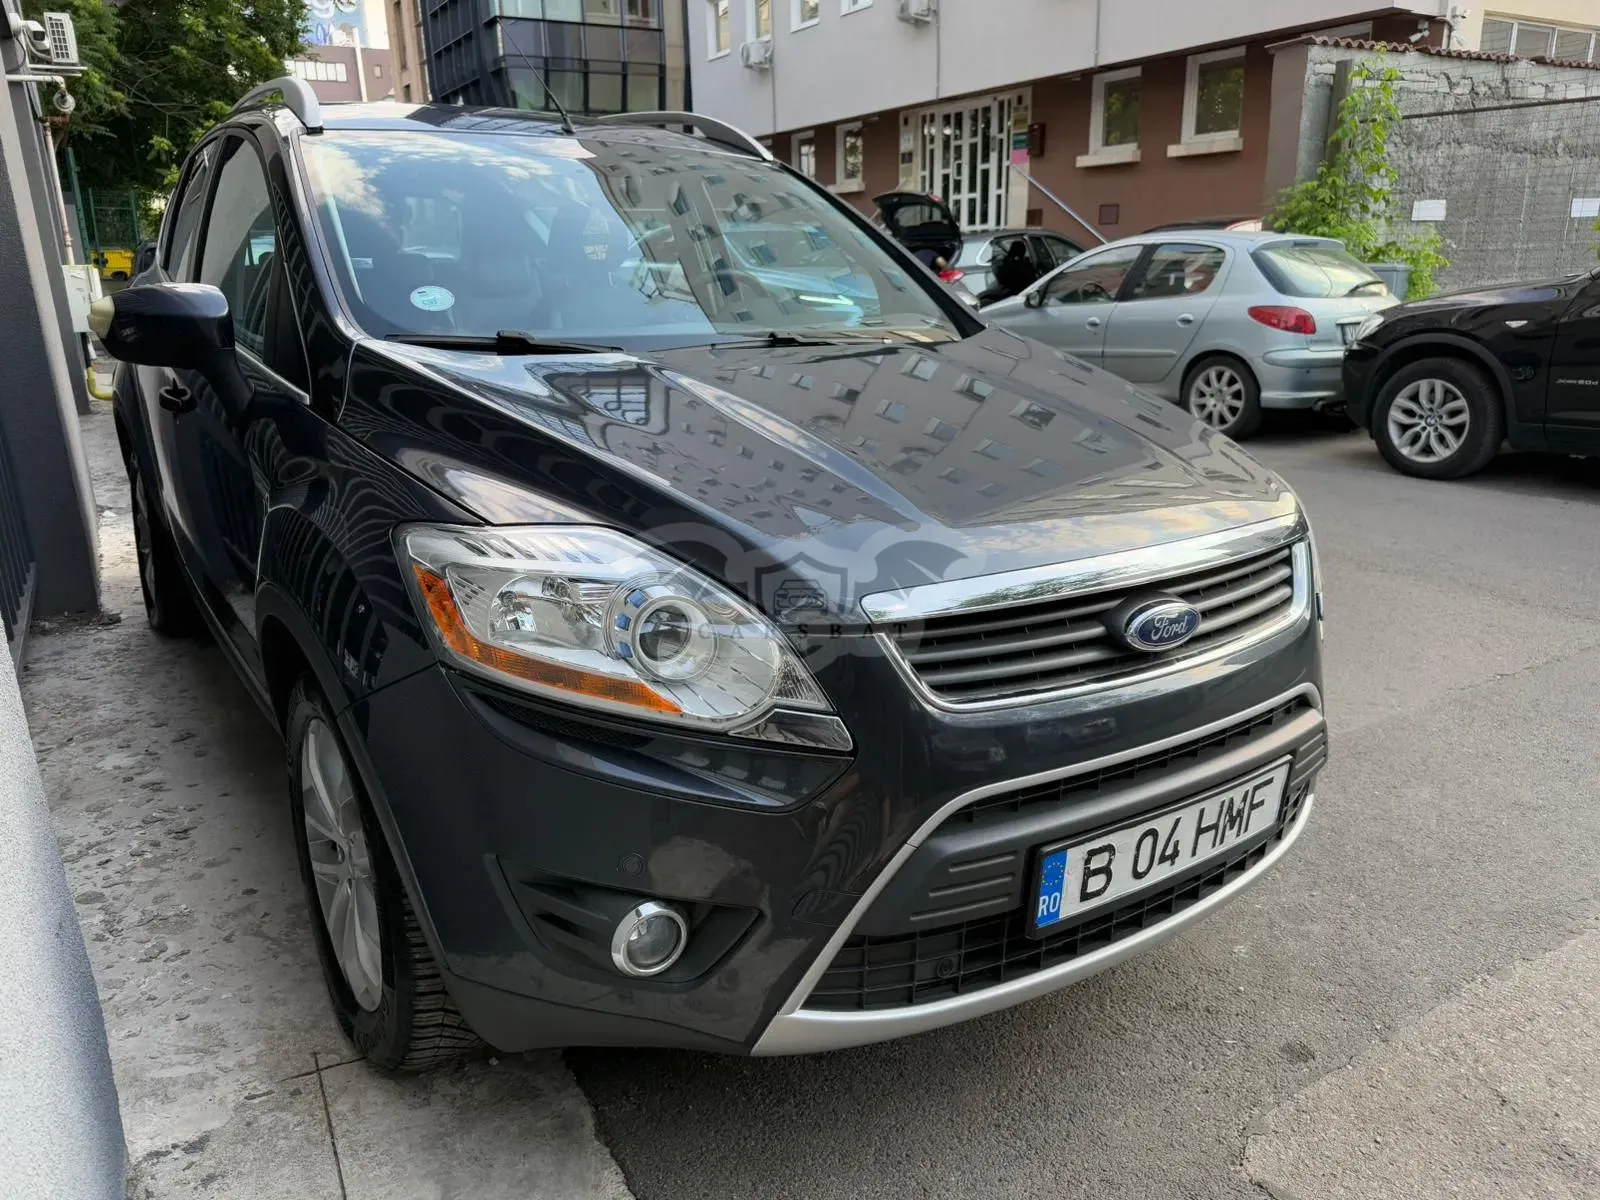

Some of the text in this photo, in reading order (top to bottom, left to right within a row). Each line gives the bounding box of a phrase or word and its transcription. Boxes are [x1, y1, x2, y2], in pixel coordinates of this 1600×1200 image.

[1151, 613, 1188, 640] Ford
[1080, 777, 1274, 902] B 04 HMF
[1037, 892, 1060, 918] RO
